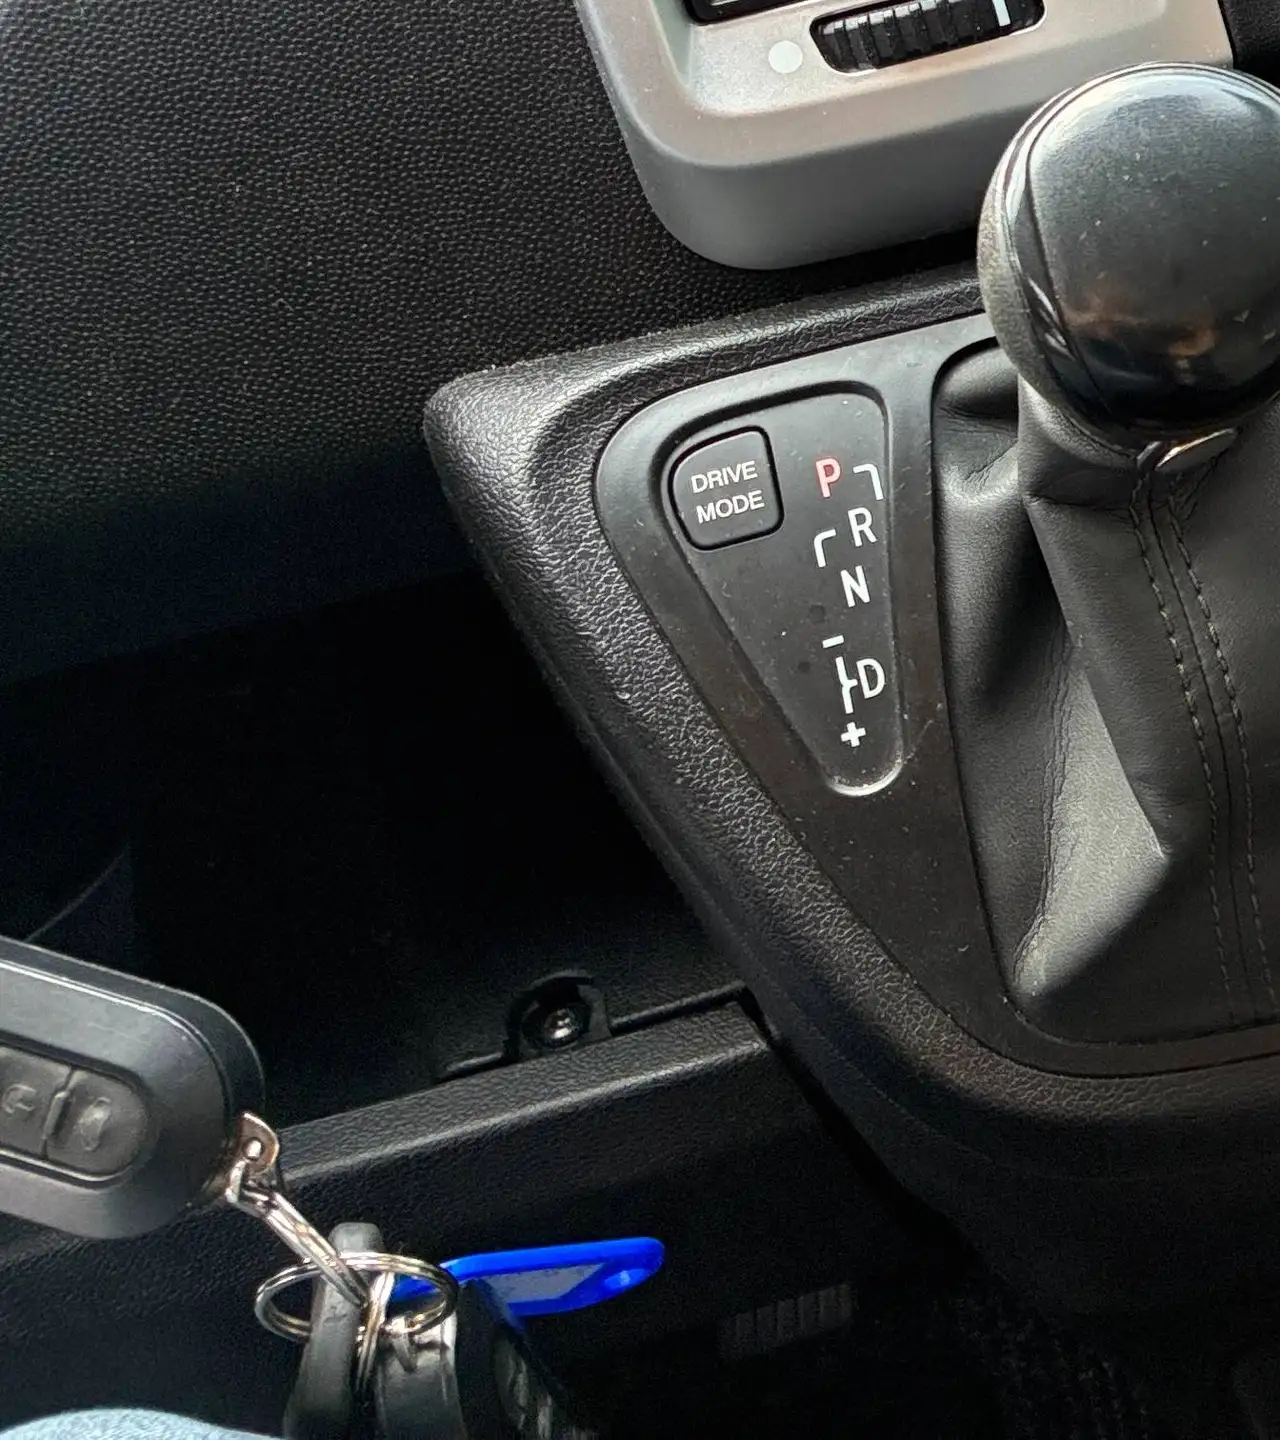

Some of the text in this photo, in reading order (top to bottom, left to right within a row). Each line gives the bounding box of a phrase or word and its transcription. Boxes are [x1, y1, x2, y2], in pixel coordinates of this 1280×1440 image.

[690, 460, 759, 494] DRIVE
[814, 457, 842, 498] P
[695, 491, 766, 525] MODE
[847, 506, 878, 548] R
[840, 565, 871, 608] N
[857, 658, 886, 699] D
